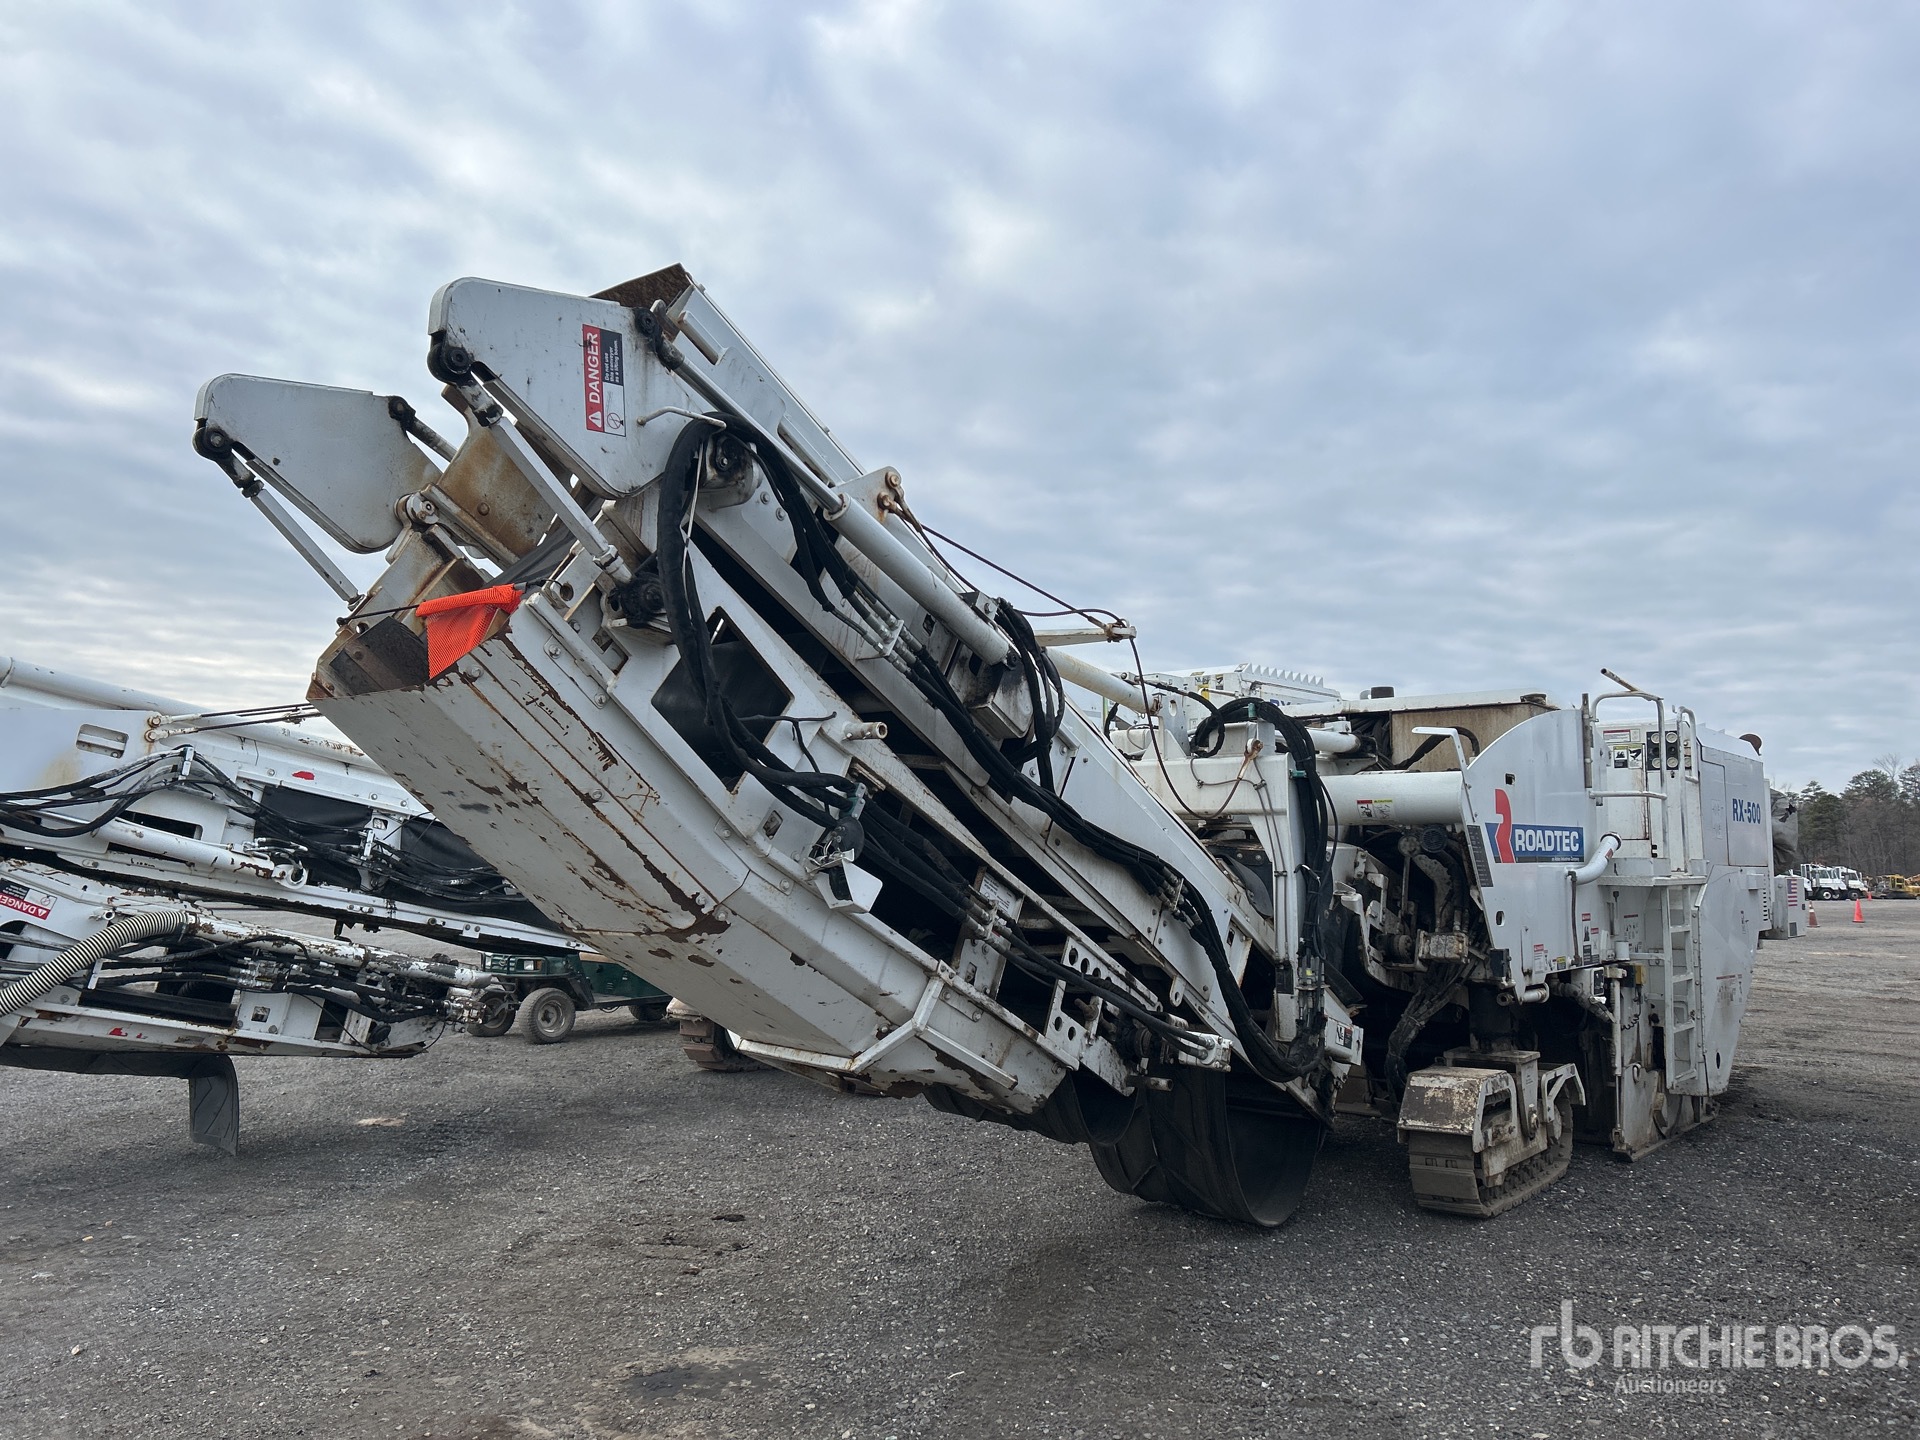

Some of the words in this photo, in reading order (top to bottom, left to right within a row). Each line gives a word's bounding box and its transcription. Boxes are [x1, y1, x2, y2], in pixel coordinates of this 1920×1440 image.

[587, 332, 600, 404] DANGER
[1732, 798, 1761, 825] RX-500
[1515, 829, 1579, 852] ROADTEC
